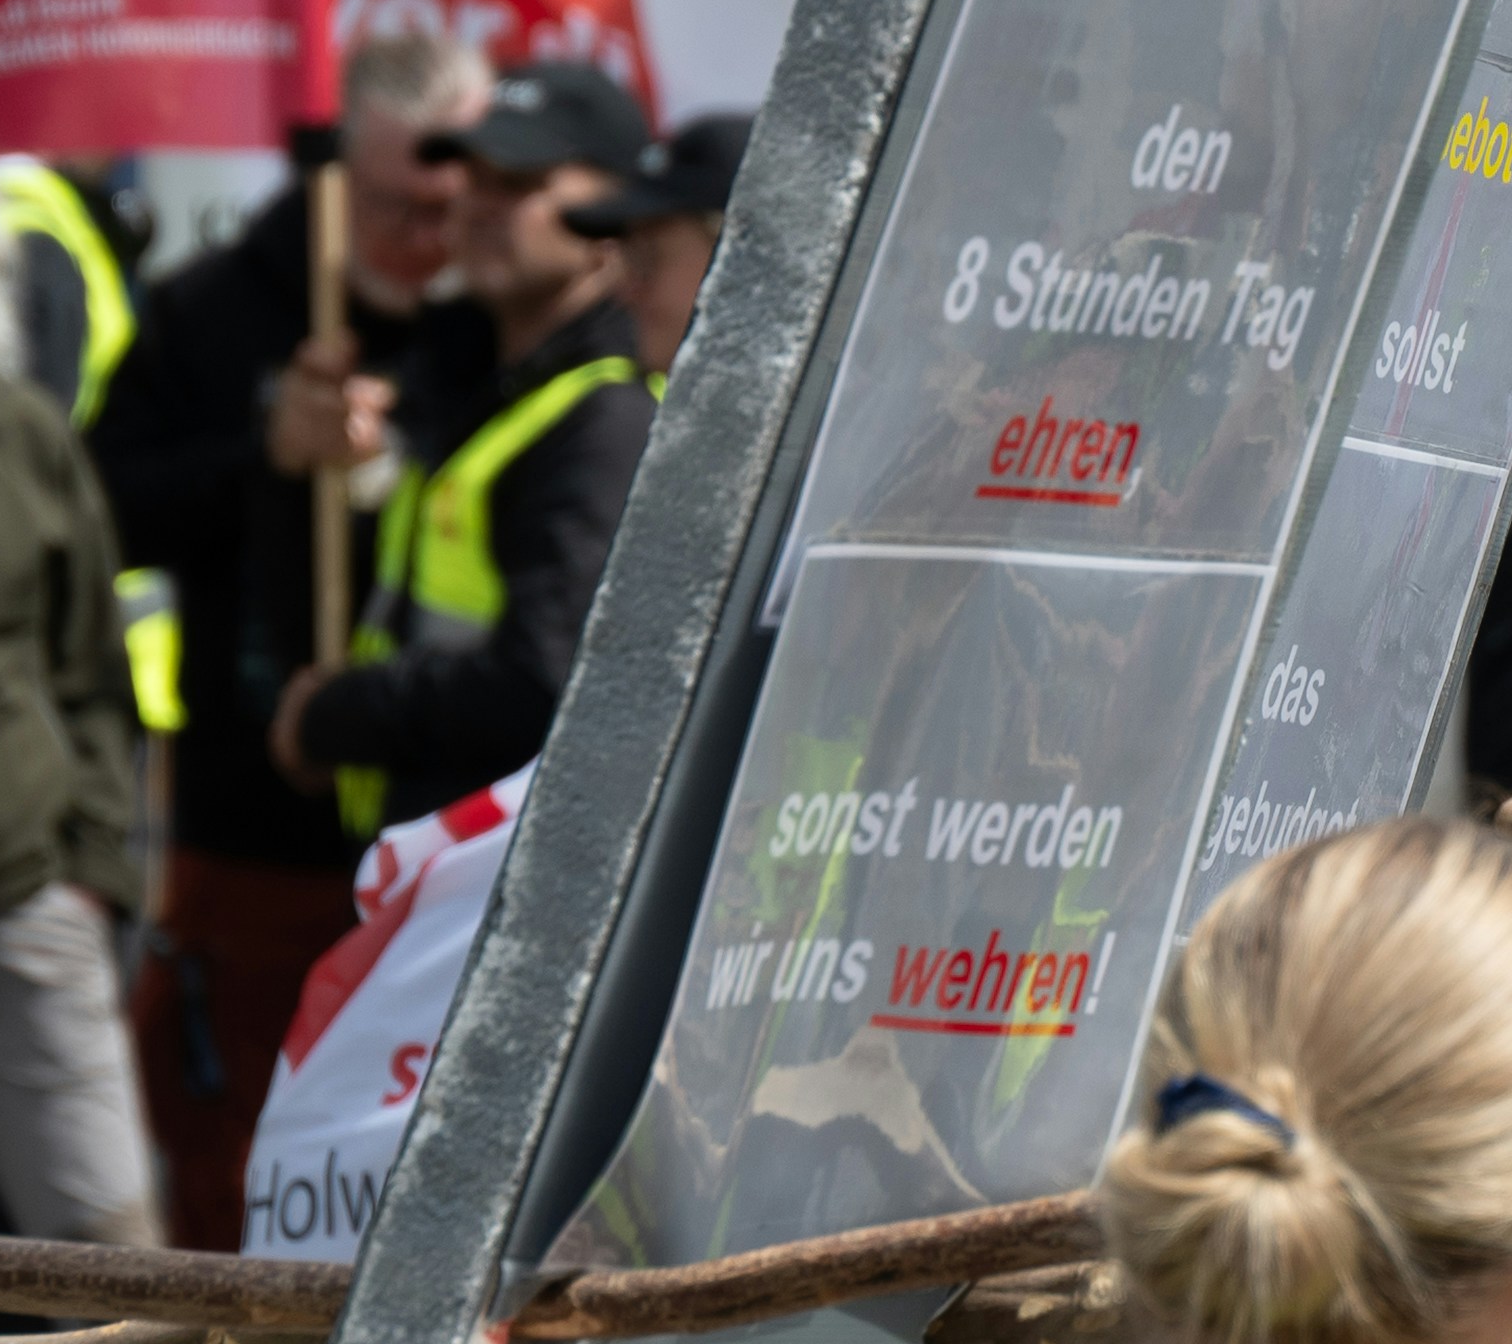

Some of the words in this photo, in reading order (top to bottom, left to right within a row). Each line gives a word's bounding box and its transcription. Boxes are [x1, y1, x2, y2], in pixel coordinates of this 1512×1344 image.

[1131, 102, 1234, 194] den
[943, 235, 989, 325] 8
[994, 240, 1214, 341] Stunden
[1219, 260, 1317, 372] Tag
[1375, 309, 1467, 394] sollst
[1261, 644, 1326, 728] das
[769, 776, 918, 858] sonst
[925, 784, 1125, 869] werden
[705, 921, 776, 1011] wir
[772, 938, 875, 1005] uns
[888, 929, 1117, 1016] wehren!
